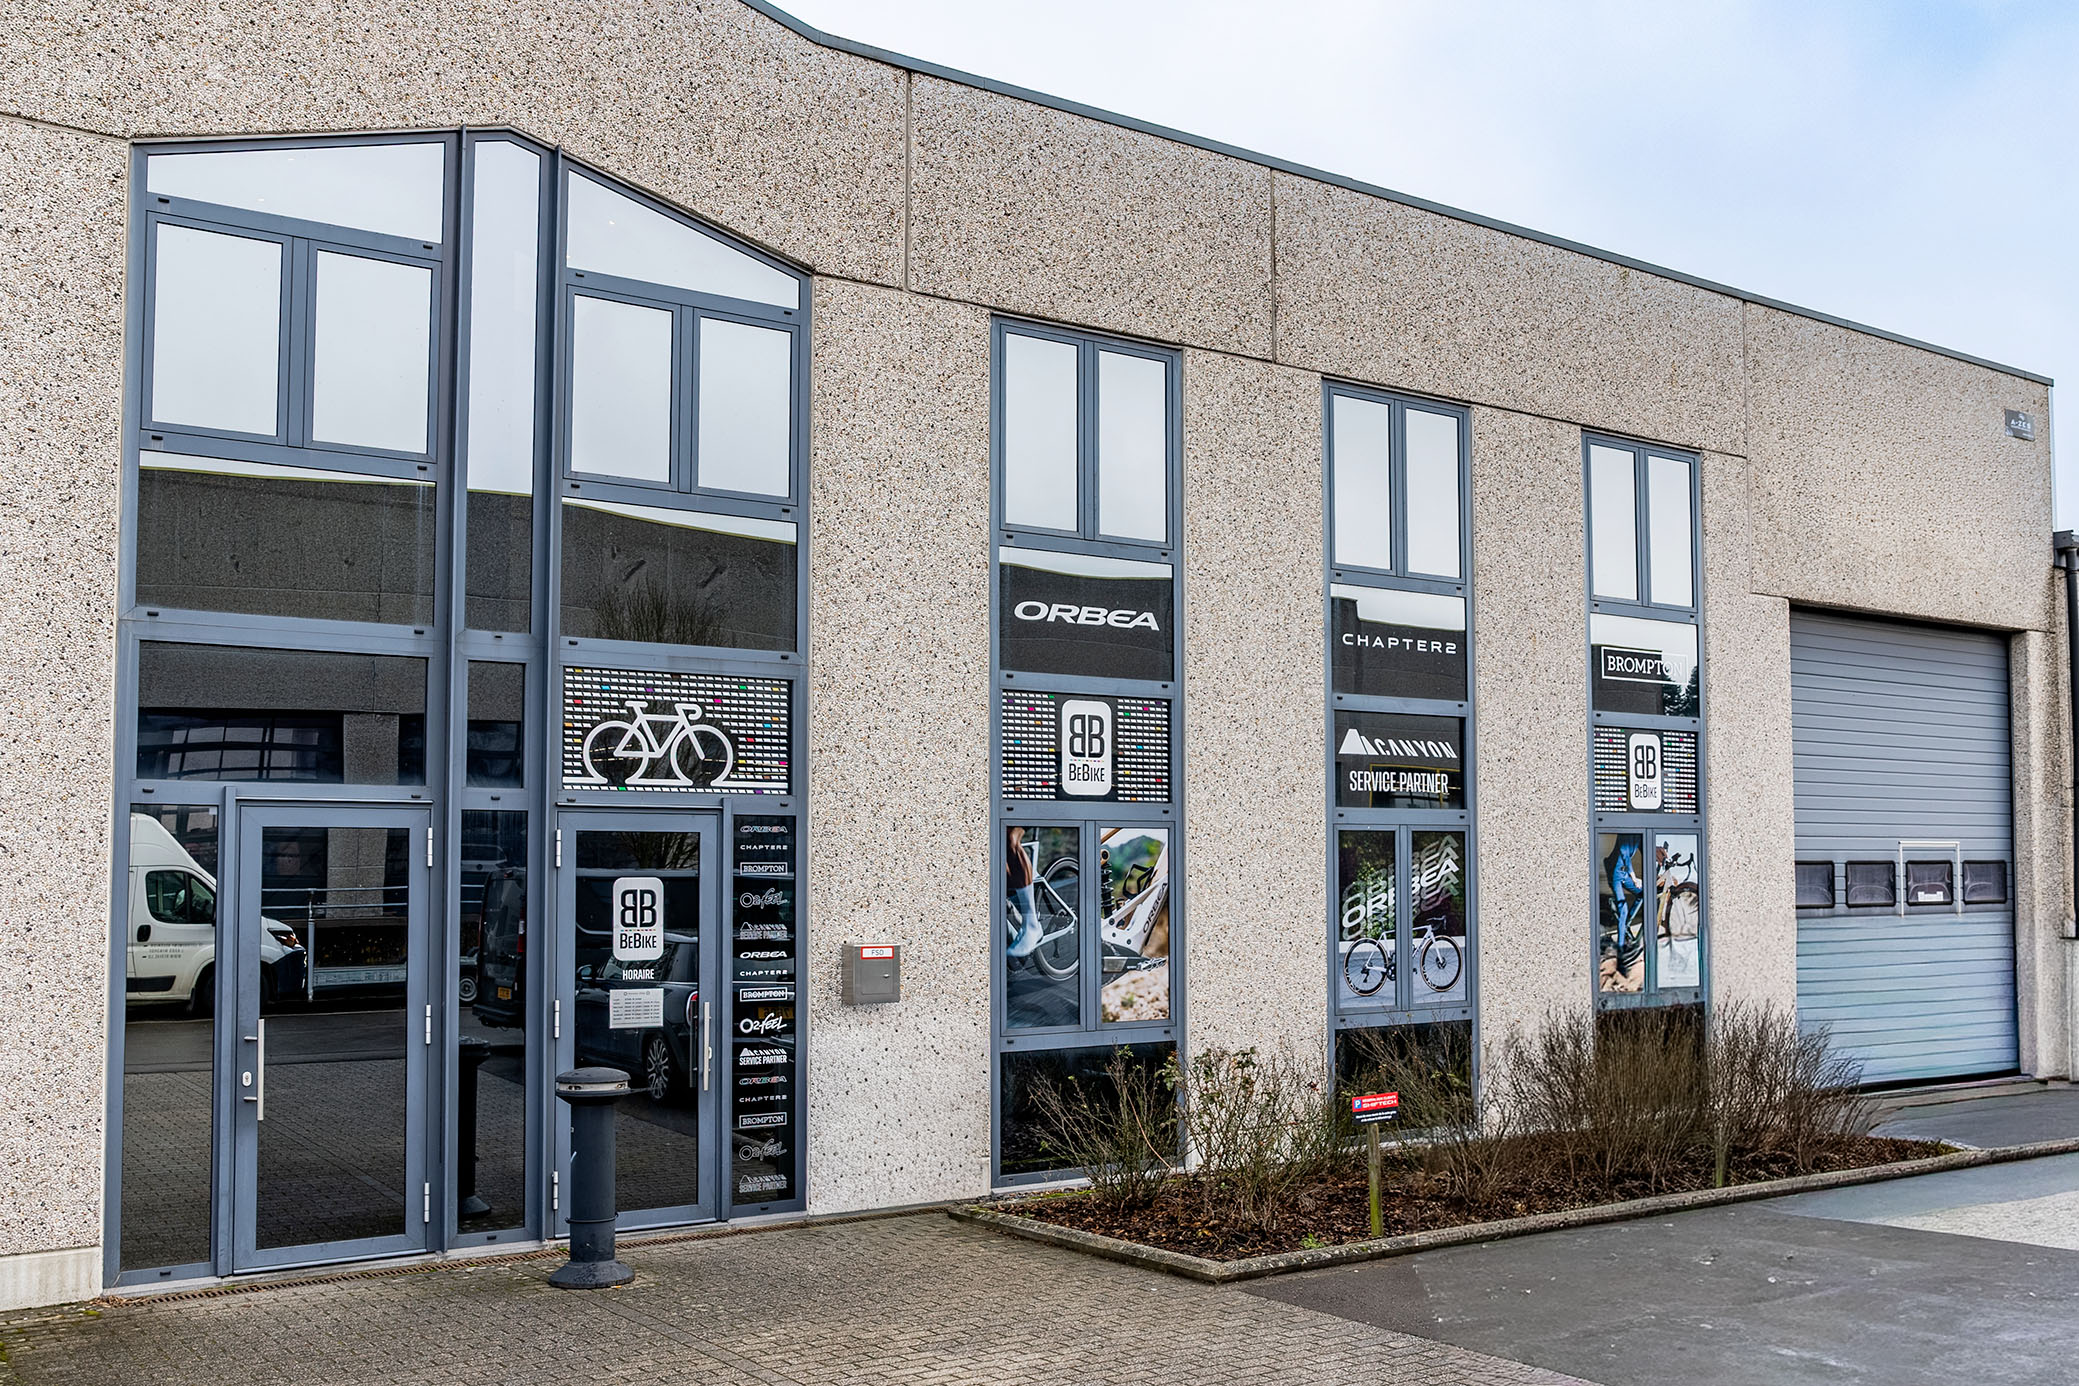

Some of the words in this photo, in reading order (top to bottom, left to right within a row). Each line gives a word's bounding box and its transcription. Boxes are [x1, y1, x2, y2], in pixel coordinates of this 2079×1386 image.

[1013, 600, 1160, 631] ORBEA
[1342, 633, 1457, 654] CHAPTER2
[1607, 655, 1682, 677] BROMPTON
[1374, 738, 1458, 759] CANYON
[1349, 770, 1397, 792] SERVICE
[1400, 772, 1450, 795] PARTNER
[743, 865, 785, 873] BROMPTON
[740, 951, 788, 959] ORBEA
[622, 968, 655, 981] HORAIRE
[743, 990, 785, 999] BROMPTON
[753, 1048, 788, 1056] CANYON
[739, 1056, 762, 1066] SERVICE
[762, 1055, 788, 1065] PARTNER
[742, 1115, 784, 1126] BROMPTON
